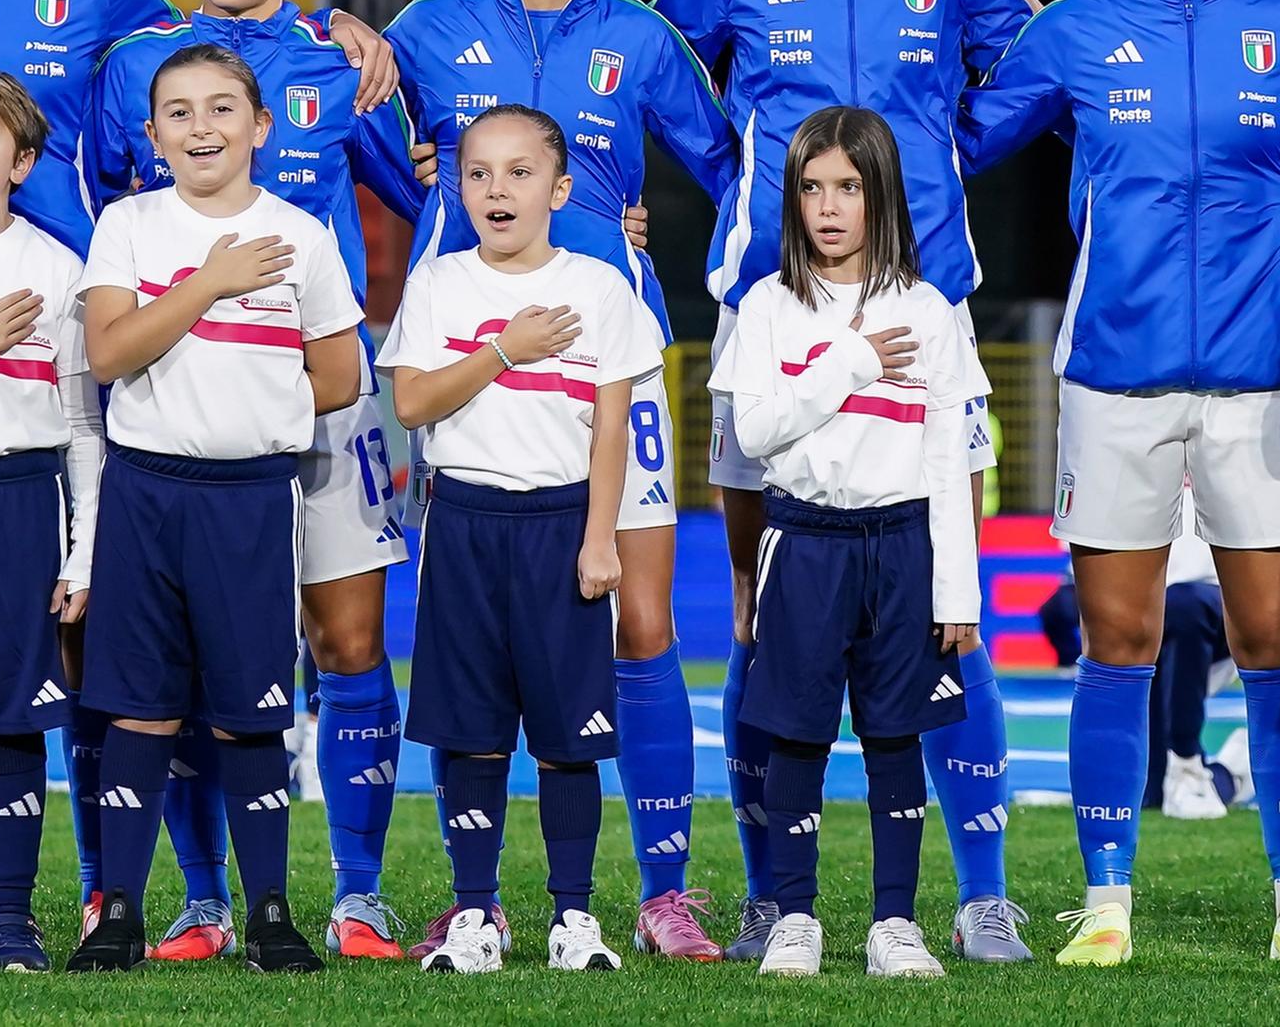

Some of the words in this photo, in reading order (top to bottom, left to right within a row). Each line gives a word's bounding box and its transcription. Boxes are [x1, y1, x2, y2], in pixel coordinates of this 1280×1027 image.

[784, 29, 812, 42] TIM
[906, 28, 938, 39] Telepass
[1245, 33, 1272, 42] ITALIA
[32, 42, 68, 52] Telepass
[594, 53, 621, 65] ITALIA
[770, 49, 812, 62] Poste
[899, 48, 920, 63] eni
[24, 62, 49, 75] eni
[289, 89, 316, 99] ITALIA
[1123, 89, 1151, 102] TIM
[1246, 91, 1277, 103] Telepass
[470, 95, 497, 108] TIM
[585, 112, 616, 127] Telepass
[1109, 108, 1151, 121] Poste
[1239, 112, 1261, 127] eni
[575, 132, 597, 148] eni
[287, 149, 320, 159] Telepass
[278, 169, 301, 183] eni
[629, 400, 665, 472] 8
[354, 427, 394, 507] 13
[337, 720, 400, 741] ITALIA
[637, 793, 693, 811] ITALIA
[1077, 805, 1131, 820] ITALIA
